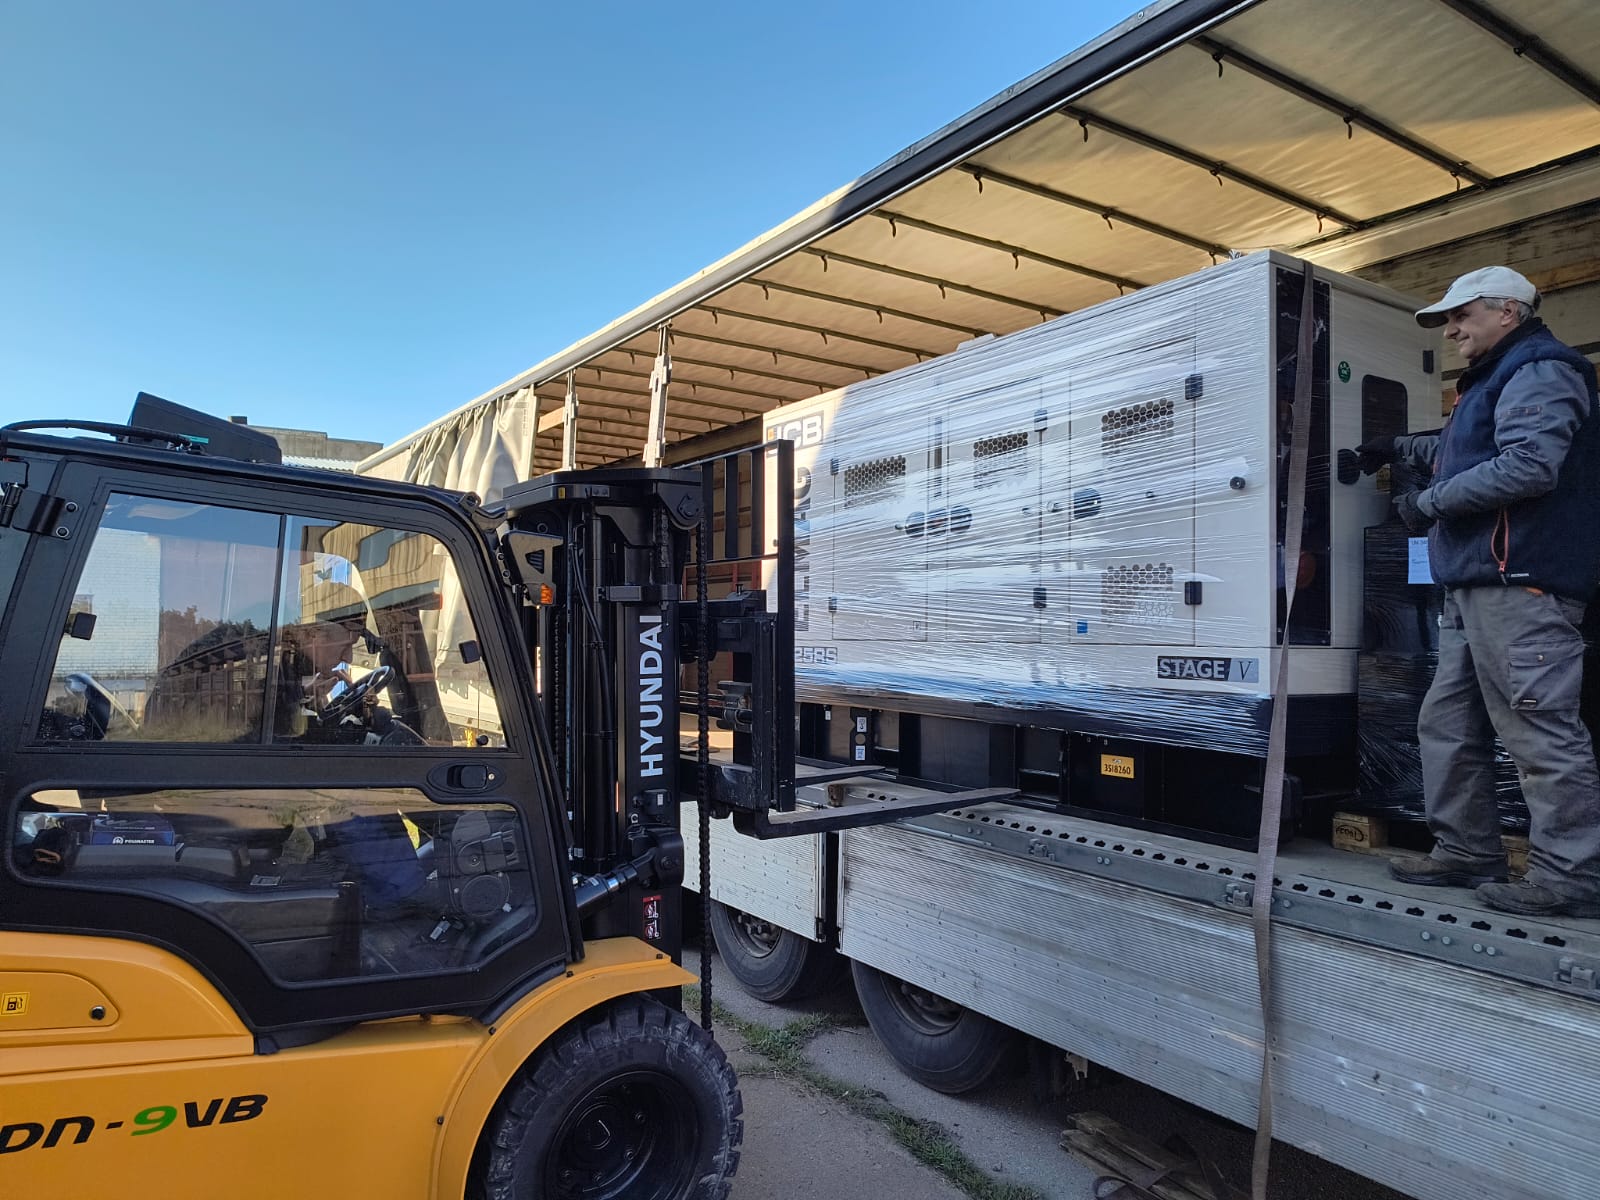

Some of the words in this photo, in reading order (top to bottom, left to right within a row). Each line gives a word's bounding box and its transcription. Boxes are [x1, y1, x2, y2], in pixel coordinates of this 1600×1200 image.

[767, 414, 823, 456] JCB
[1159, 658, 1225, 679] STAGE
[1239, 660, 1253, 680] V
[639, 615, 663, 777] HYUNDAI
